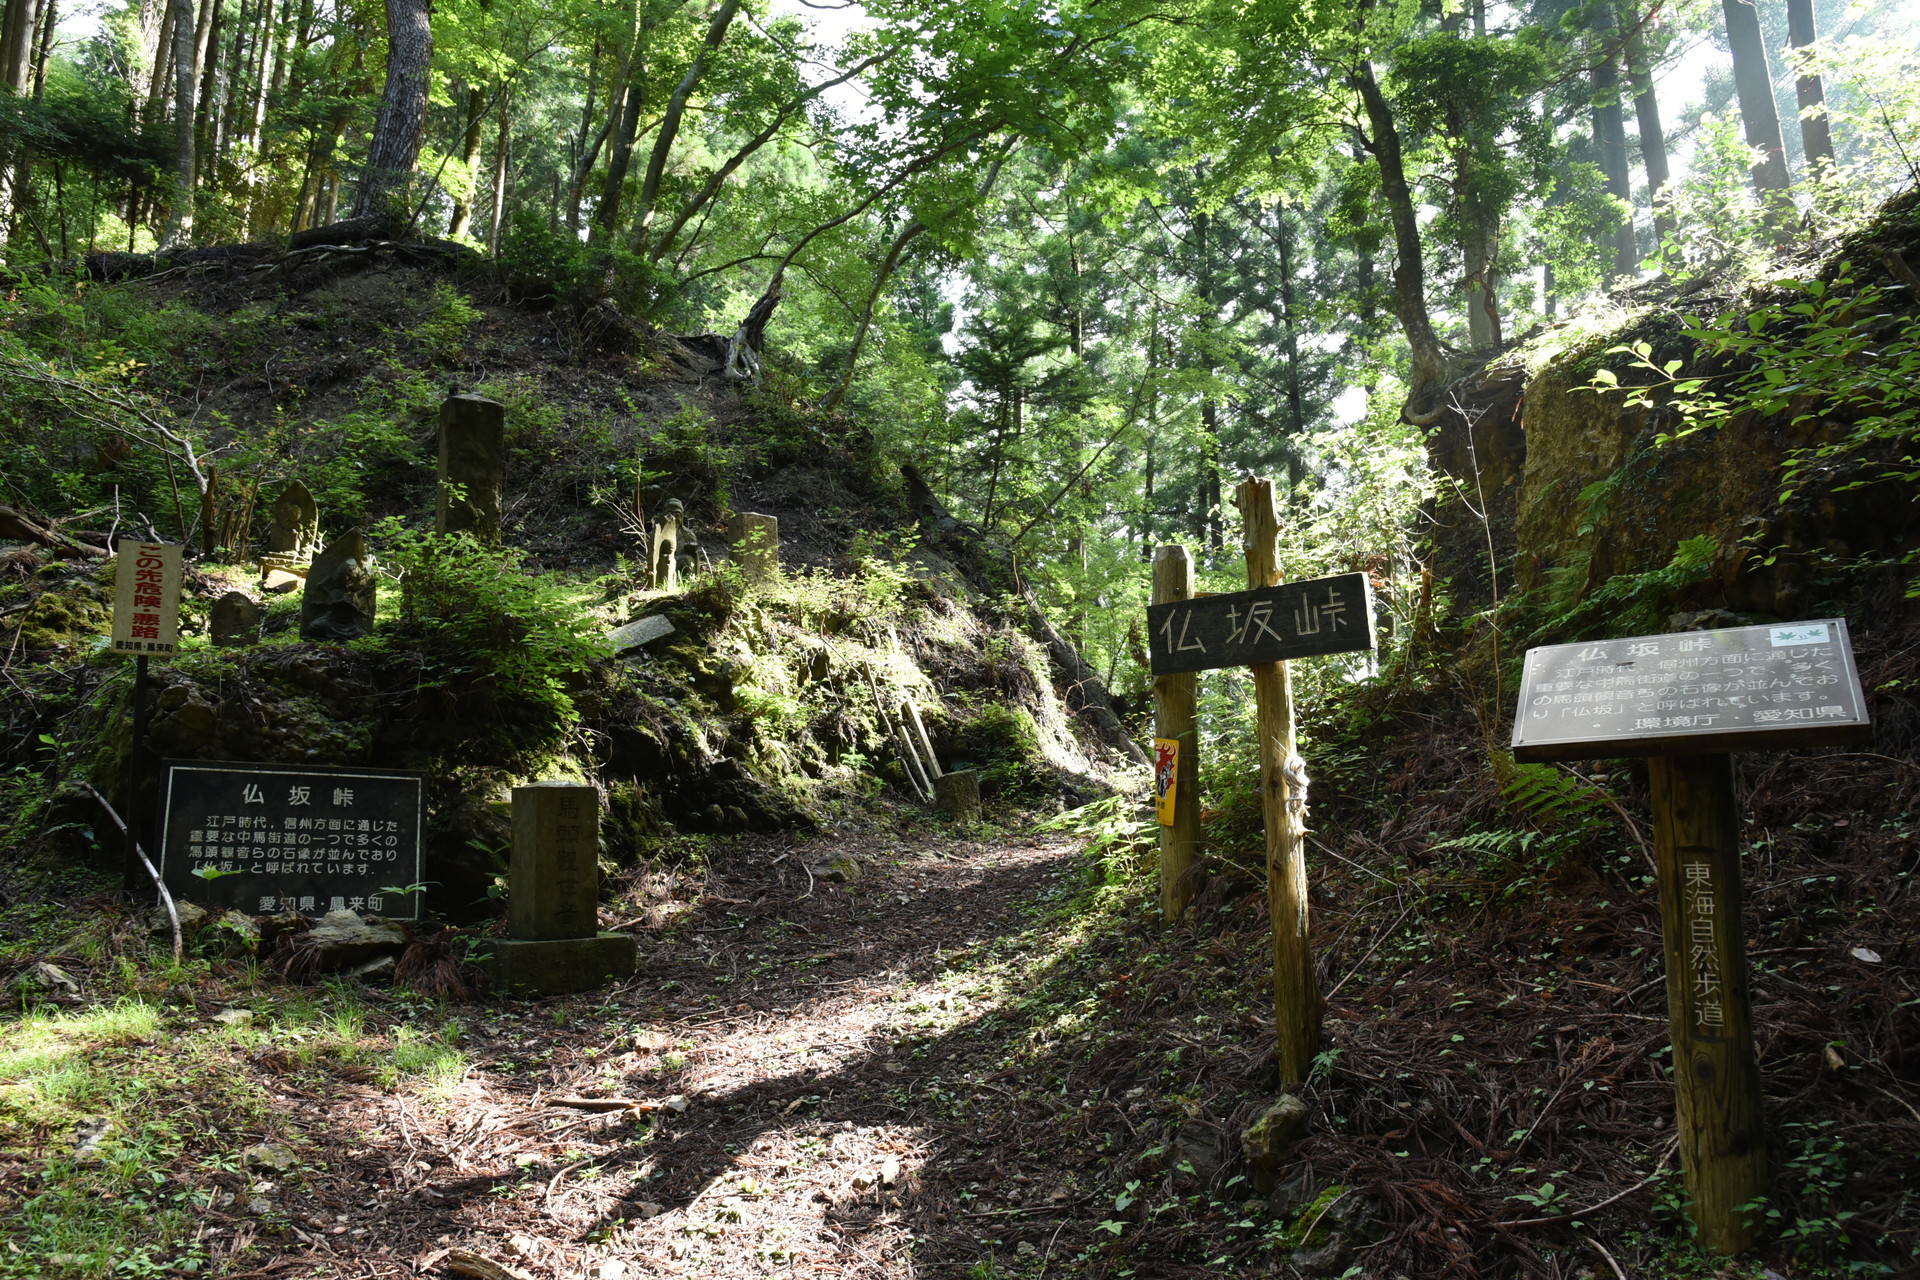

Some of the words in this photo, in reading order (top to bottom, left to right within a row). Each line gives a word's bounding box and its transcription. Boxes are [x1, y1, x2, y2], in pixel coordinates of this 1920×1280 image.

[131, 545, 164, 640] この先危険・悪路
[1159, 586, 1347, 655] 仏坂峠
[1577, 638, 1712, 661] 仏坂峠
[242, 783, 354, 807] 仏坂峠
[189, 829, 398, 847] 重要な中馬街道の一つで多くの
[188, 845, 397, 862] 馬頭観音らの石像が並んでおり
[1682, 860, 1725, 1027] 東海自然歩道
